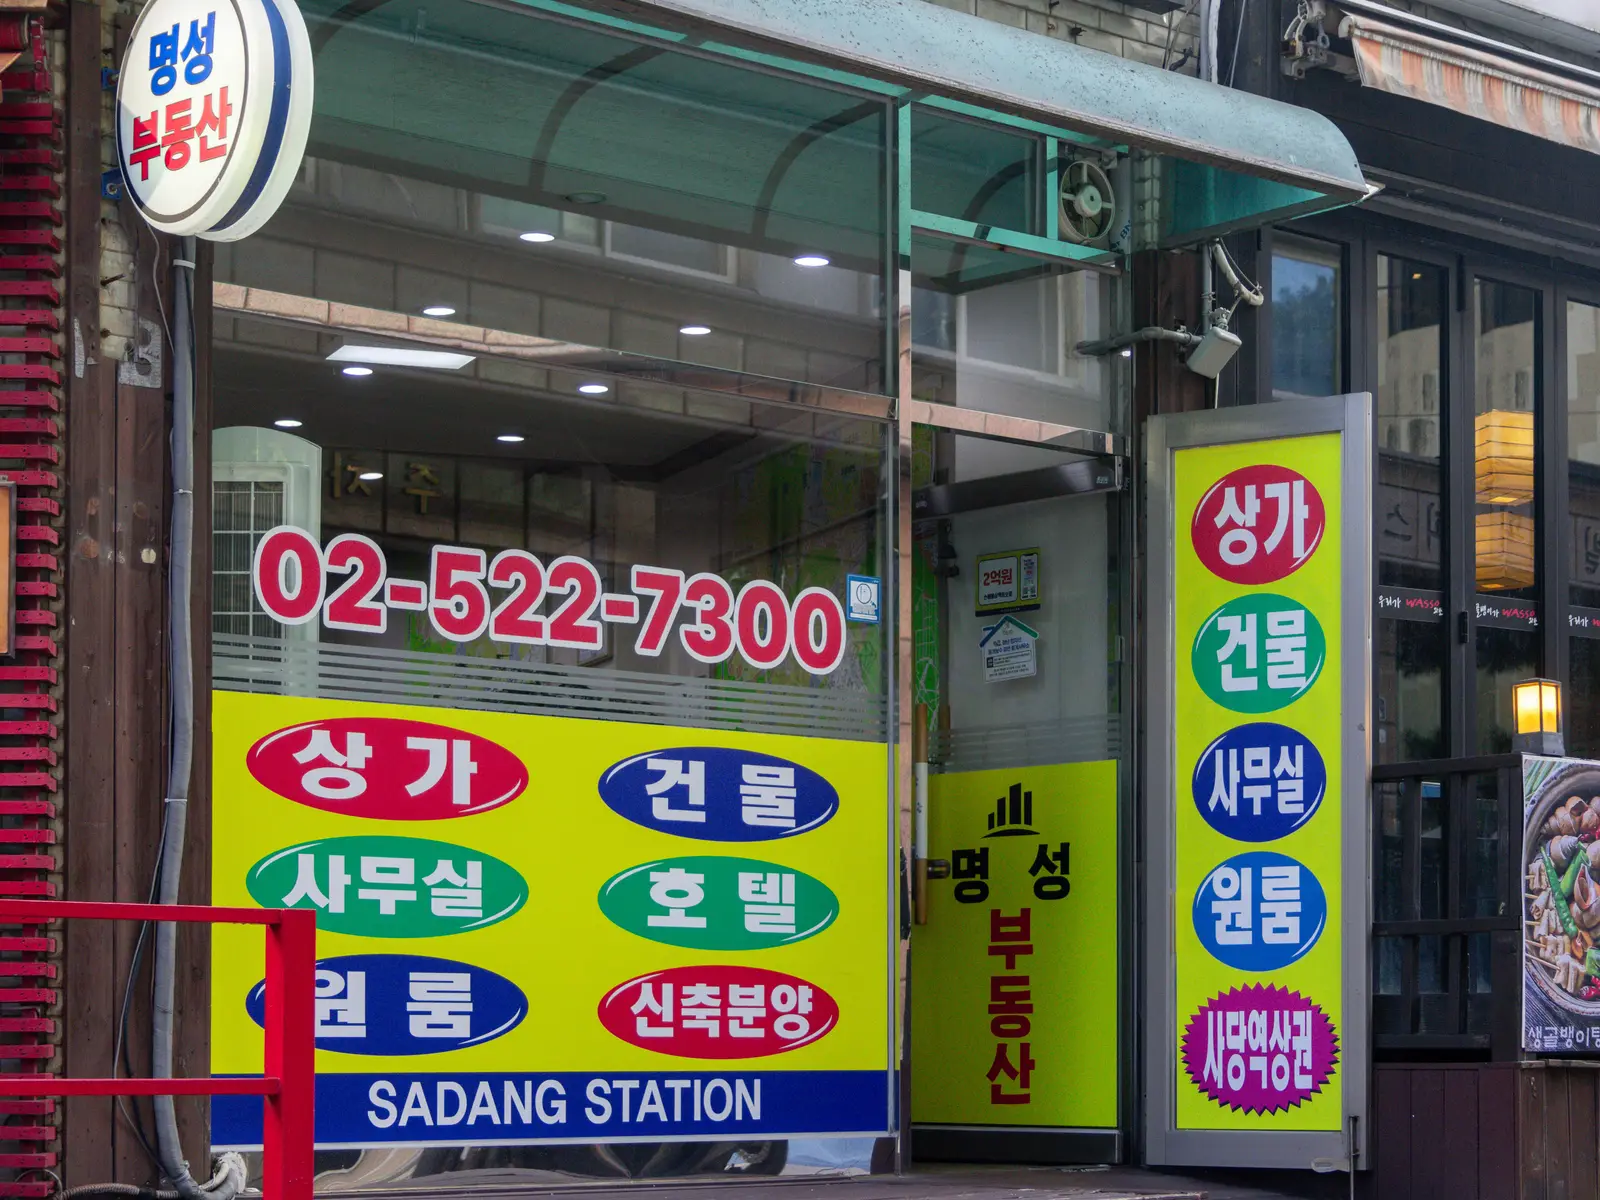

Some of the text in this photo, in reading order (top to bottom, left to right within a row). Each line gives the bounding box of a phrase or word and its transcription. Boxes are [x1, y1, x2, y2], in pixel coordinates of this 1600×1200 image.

[149, 11, 217, 97] 명성
[129, 85, 233, 182] 부동산
[1213, 479, 1309, 566] 상가
[252, 524, 847, 676] 02-522-7300
[983, 567, 1013, 587] 2억원
[1378, 595, 1441, 609] 우리가 WASSO
[1502, 607, 1536, 619] WASSO
[1216, 609, 1307, 692] 건물
[1207, 744, 1304, 817] 사무실
[280, 852, 483, 918] 사무실
[1210, 864, 1302, 945] 원룸
[629, 981, 813, 1040] 신축분양
[985, 906, 1036, 1105] 부동산
[1202, 1008, 1314, 1092] 사당역상권
[366, 1077, 762, 1129] SADANG STATION
